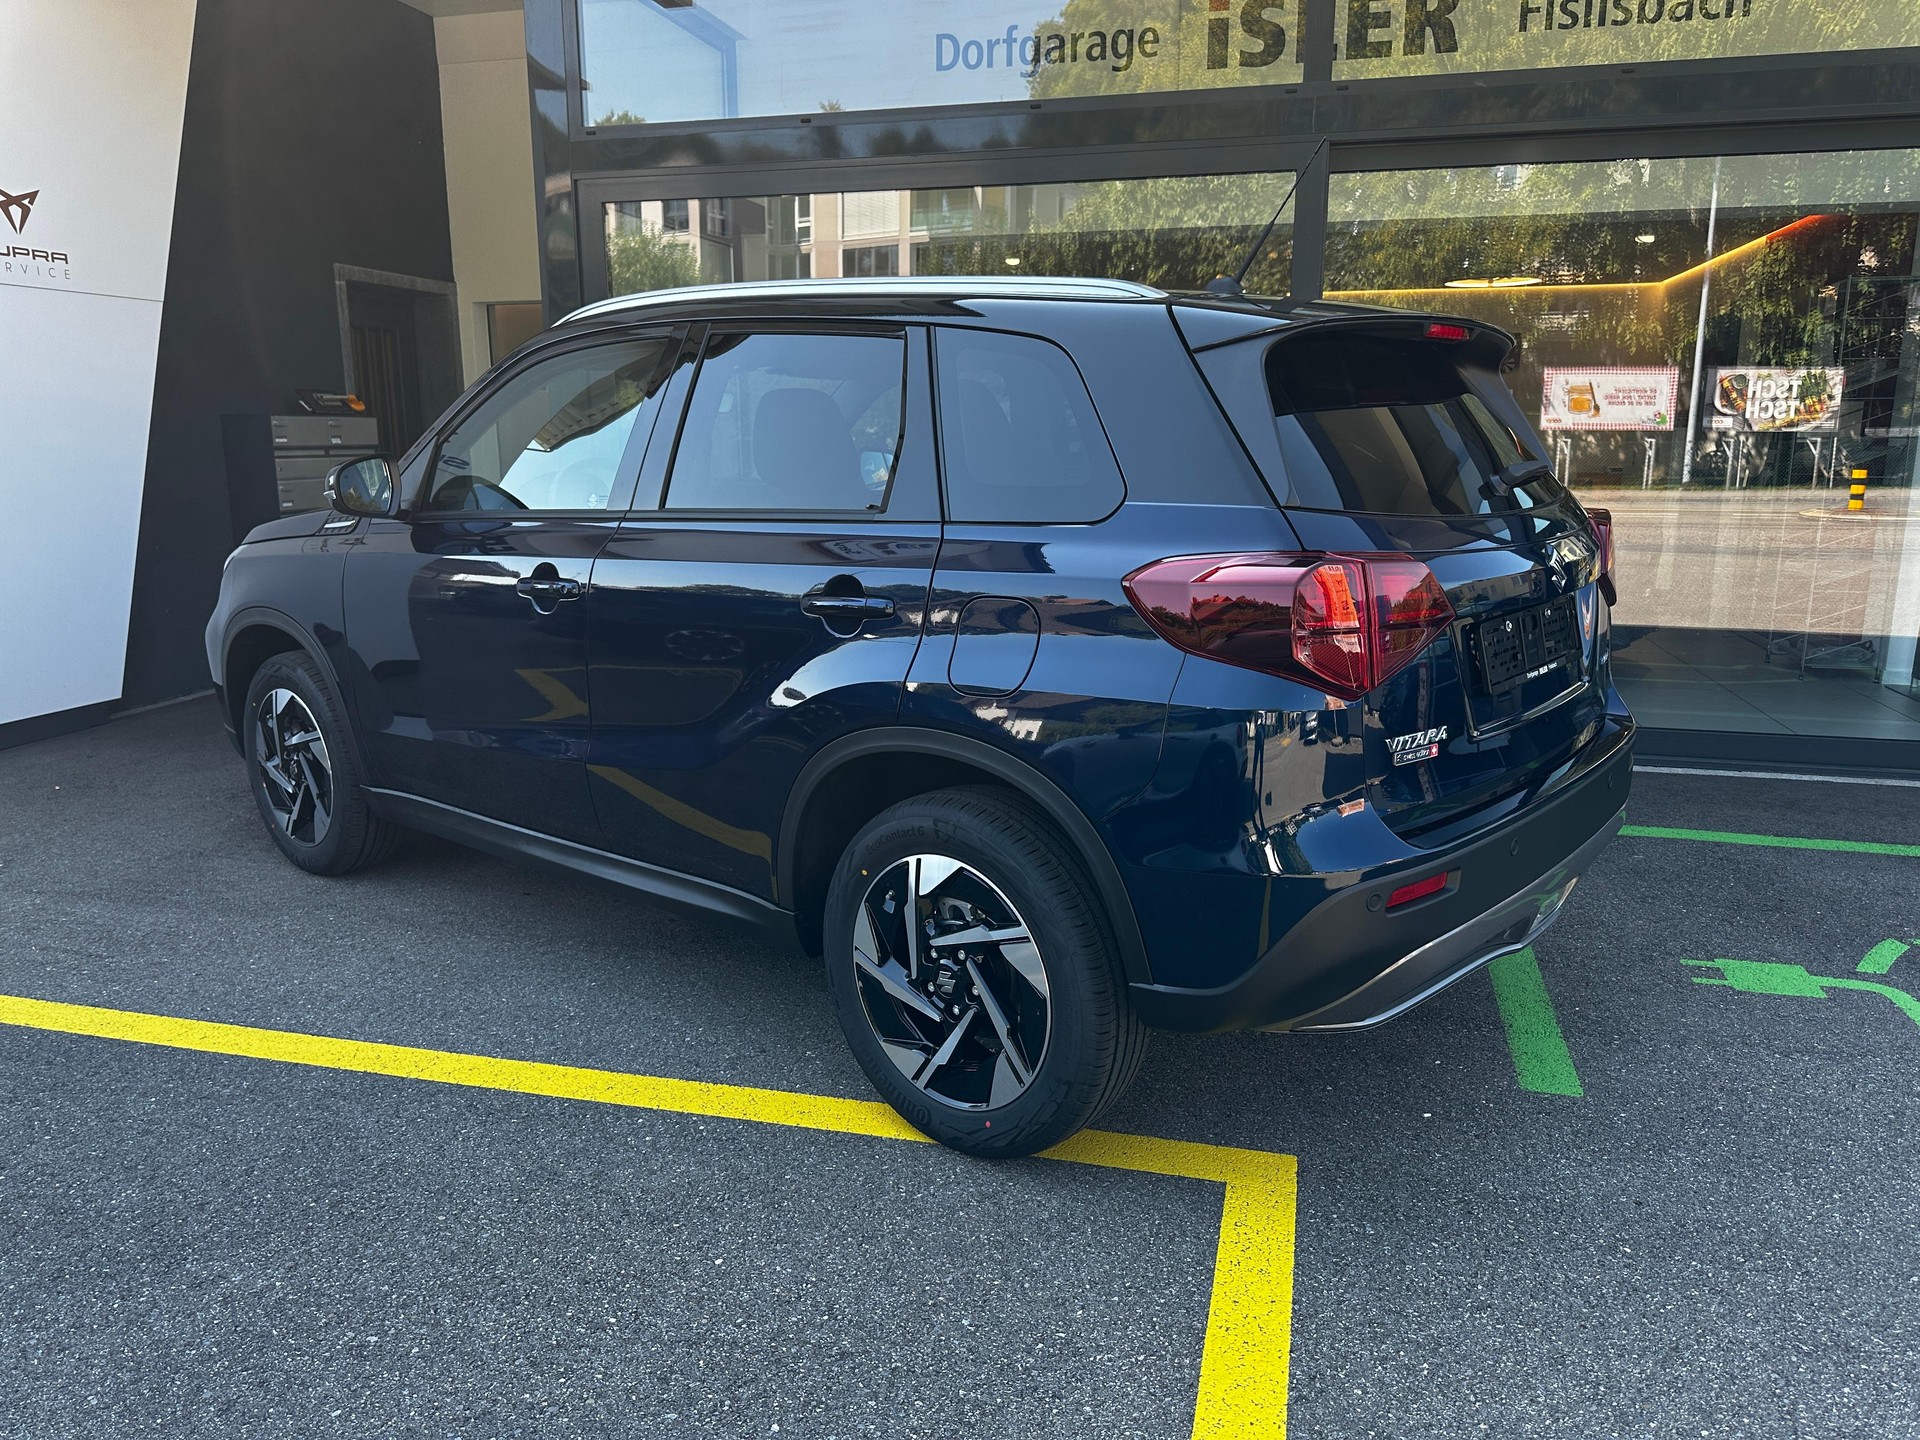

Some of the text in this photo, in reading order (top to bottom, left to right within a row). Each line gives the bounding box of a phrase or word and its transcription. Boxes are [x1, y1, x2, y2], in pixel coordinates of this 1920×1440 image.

[935, 25, 1160, 78] Dorfgarage
[0, 246, 69, 264] UPRA
[5, 262, 70, 280] RVICE
[1385, 725, 1448, 753] VITARA
